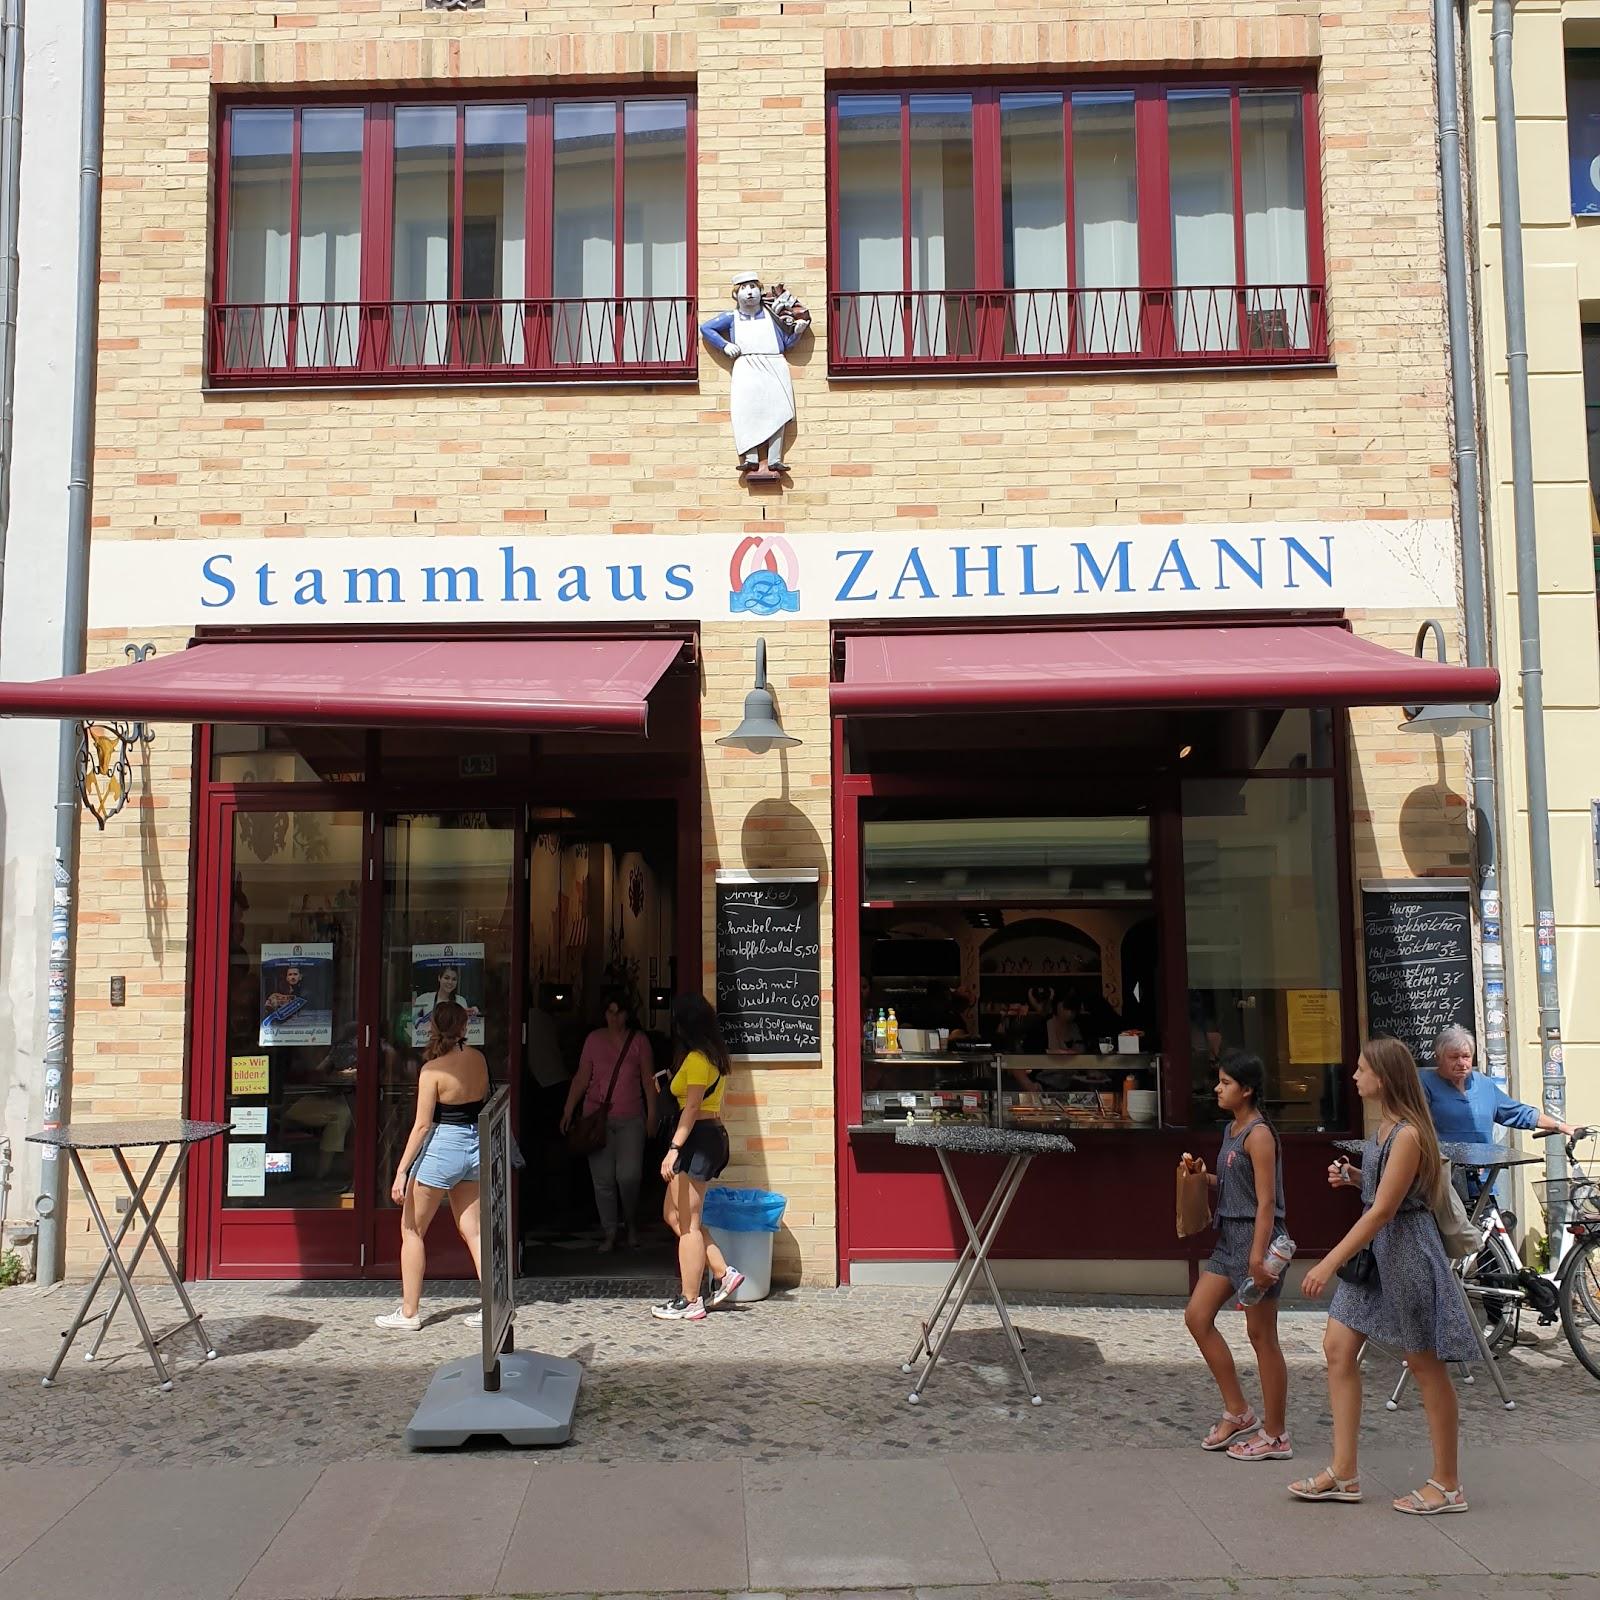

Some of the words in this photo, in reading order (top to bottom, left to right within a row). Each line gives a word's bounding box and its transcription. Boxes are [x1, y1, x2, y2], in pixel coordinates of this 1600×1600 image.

[201, 546, 693, 607] Stammhaus
[836, 536, 1334, 602] ZAHLMANN
[772, 914, 801, 933] mit
[1393, 932, 1416, 942] oder
[794, 943, 819, 958] 5,50
[1421, 966, 1436, 977] im
[771, 972, 798, 989] mit
[1433, 986, 1448, 997] im
[738, 991, 788, 1008] Nudeln
[791, 993, 820, 1009] 6,20
[1432, 1010, 1454, 1023] mit
[794, 1033, 820, 1047] 4,25
[249, 1058, 266, 1067] Wir
[234, 1070, 259, 1079] bilden
[233, 1084, 251, 1092] aus!
